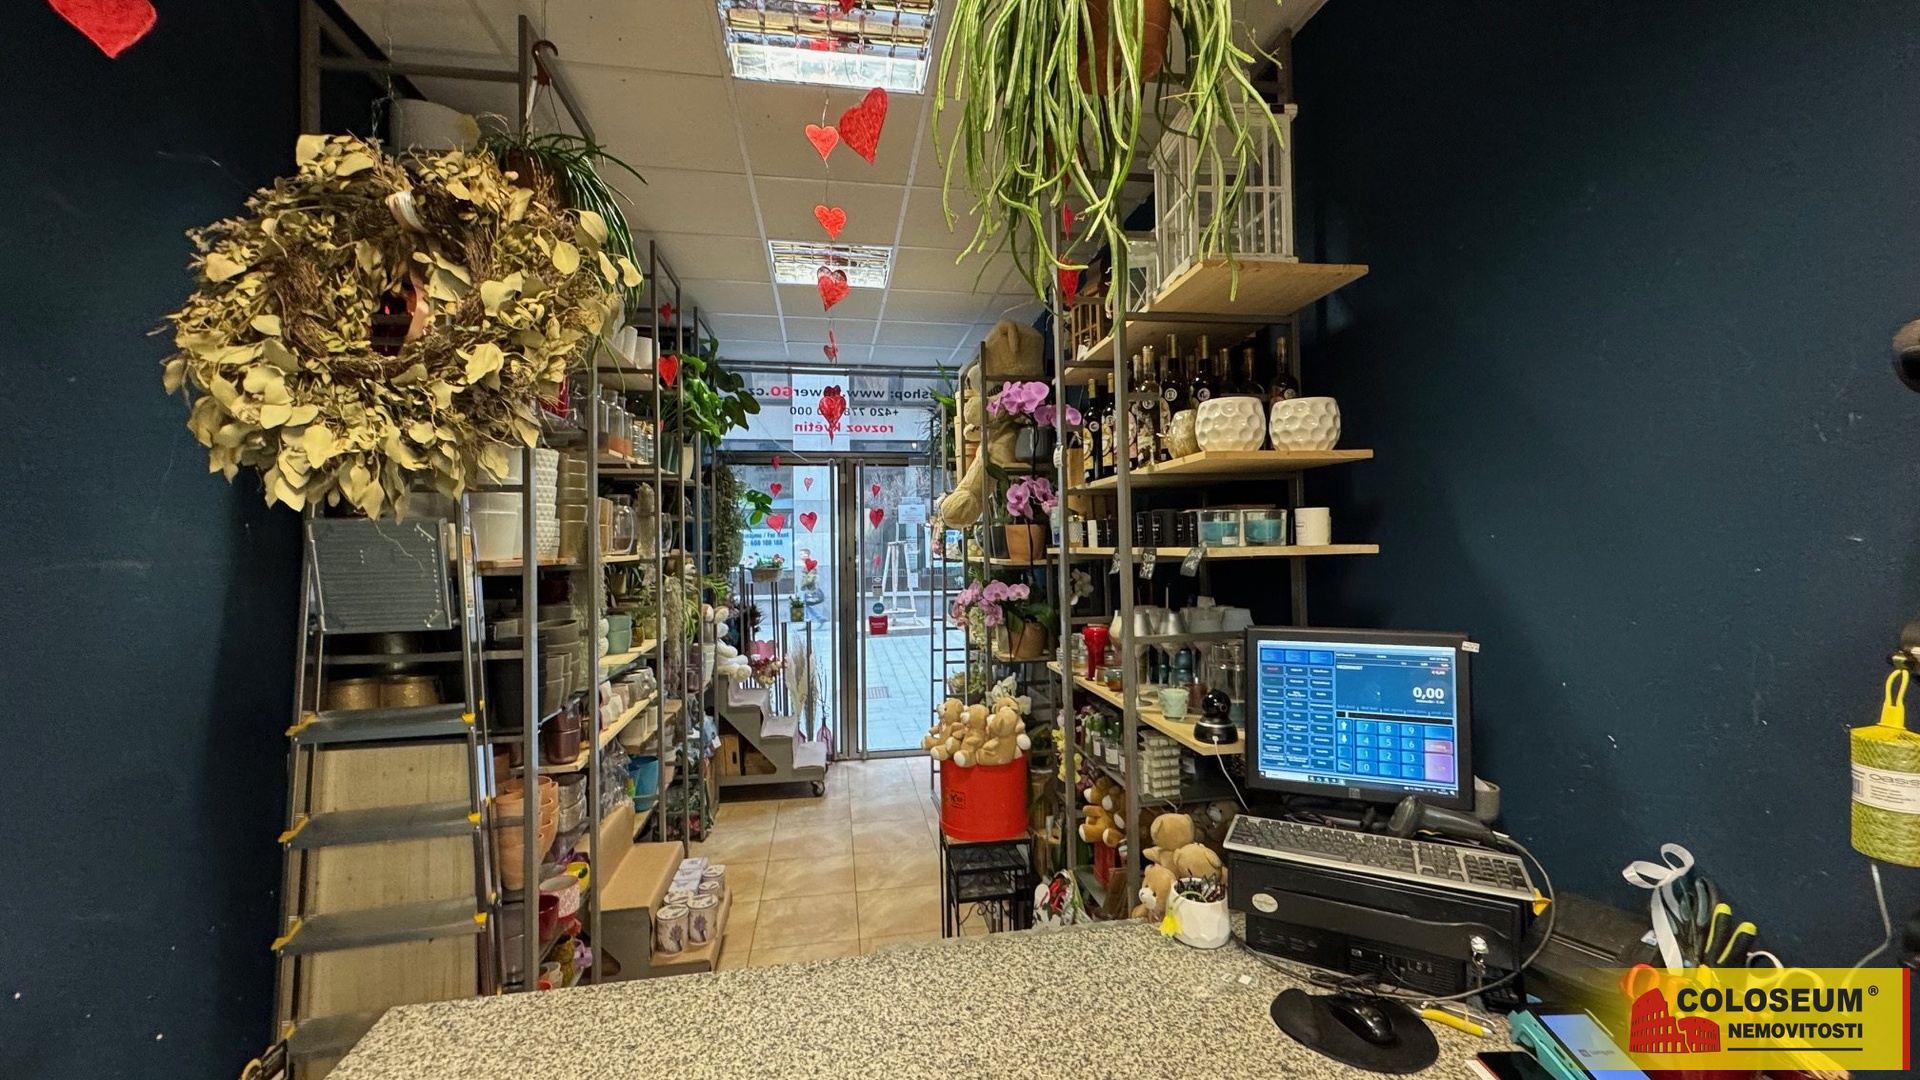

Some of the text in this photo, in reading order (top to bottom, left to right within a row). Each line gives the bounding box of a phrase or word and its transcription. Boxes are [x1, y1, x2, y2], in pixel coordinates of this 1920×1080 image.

[1412, 686, 1445, 700] 0,00
[1385, 725, 1392, 733] 8
[1408, 726, 1415, 734] 9
[1408, 740, 1415, 748] 6
[1386, 752, 1392, 760] 2
[1409, 754, 1415, 762] 3
[1363, 763, 1370, 771] 0
